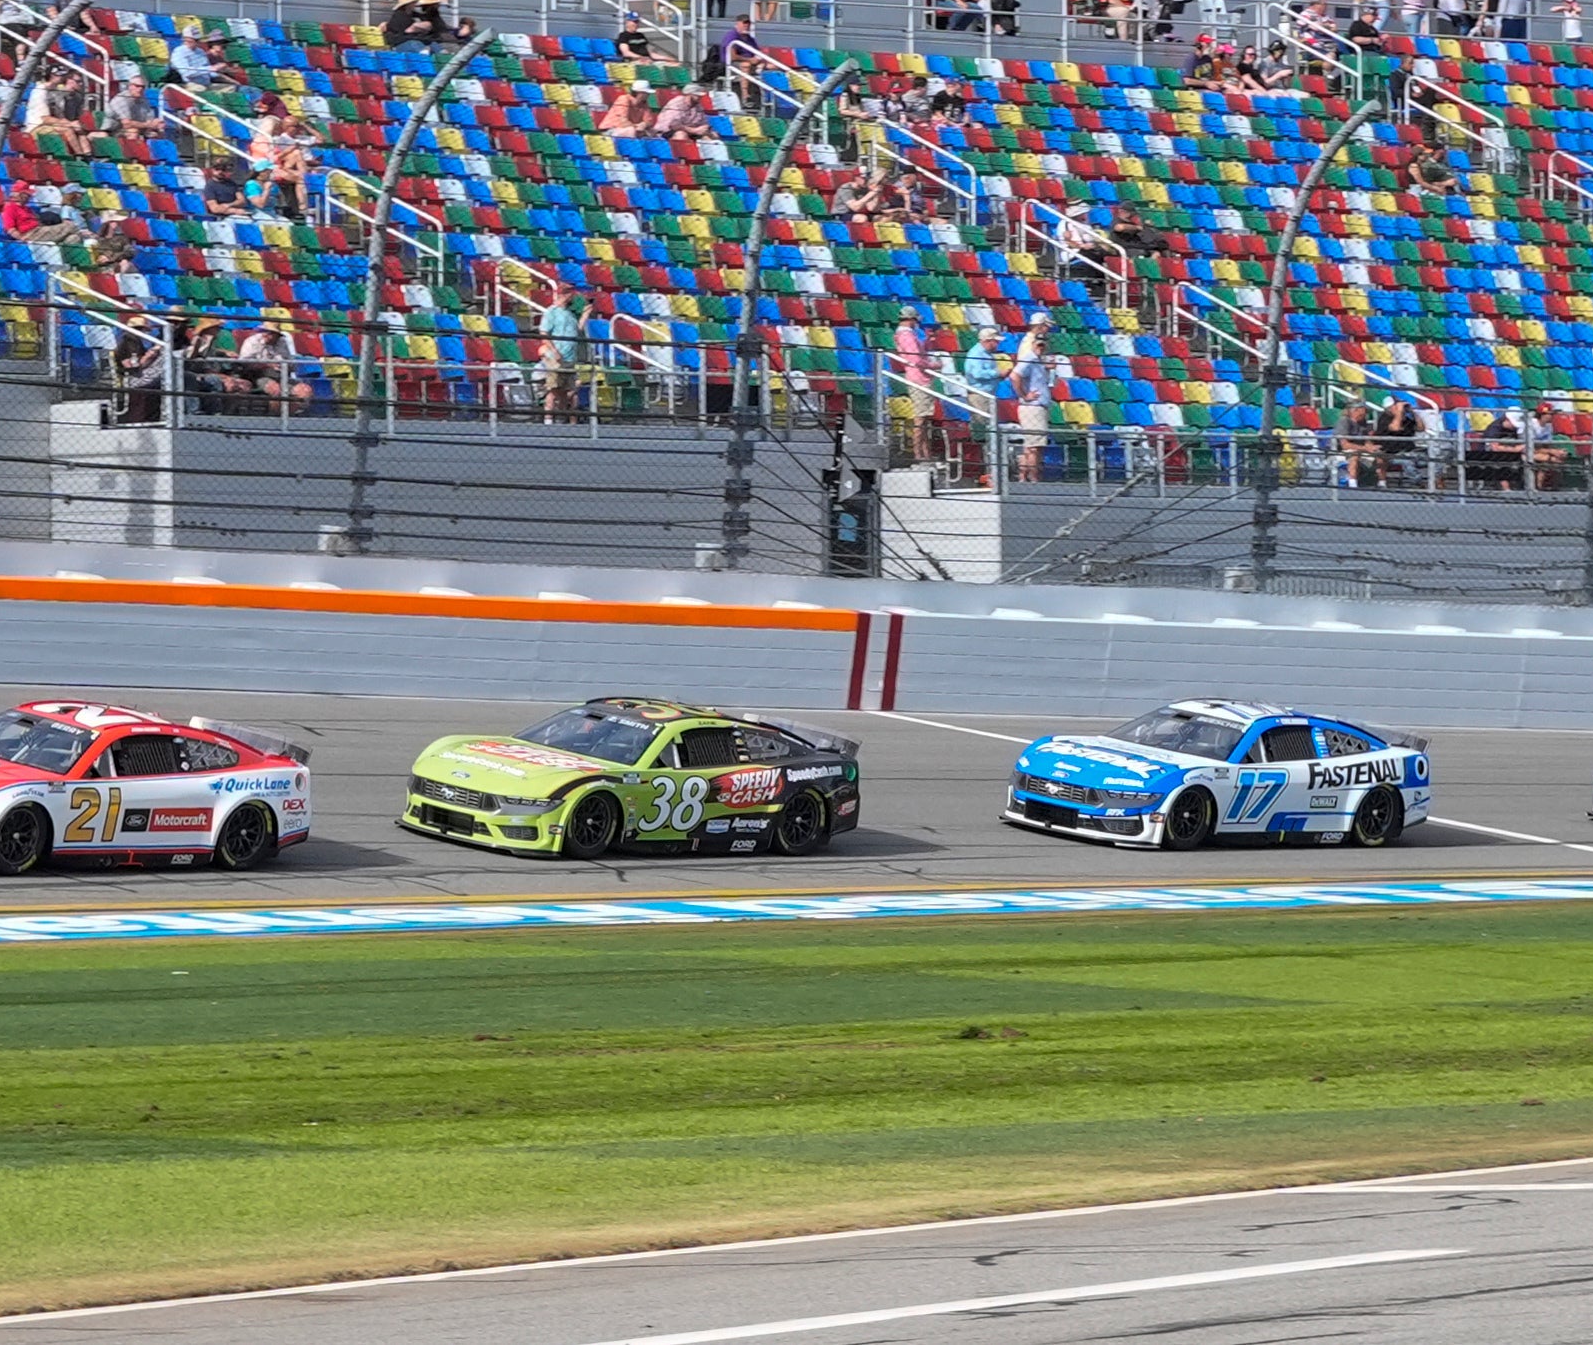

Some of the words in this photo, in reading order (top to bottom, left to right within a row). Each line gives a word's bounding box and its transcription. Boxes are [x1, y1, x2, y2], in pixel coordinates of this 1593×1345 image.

[52, 722, 85, 734] BERRY
[620, 719, 649, 730] SMITH
[731, 768, 781, 791] SPEEDY
[1307, 762, 1401, 790] FASTENAL
[225, 778, 263, 793] Quick
[264, 777, 291, 790] Lane
[1225, 769, 1288, 824] 17
[283, 799, 305, 811] DEX
[638, 776, 708, 831] 38
[63, 786, 121, 843] 21
[154, 813, 207, 826] Motorcraft
[732, 817, 769, 829] Aaron's
[1322, 832, 1344, 841] FORD
[732, 839, 757, 849] FORD
[172, 854, 194, 863] FORD
